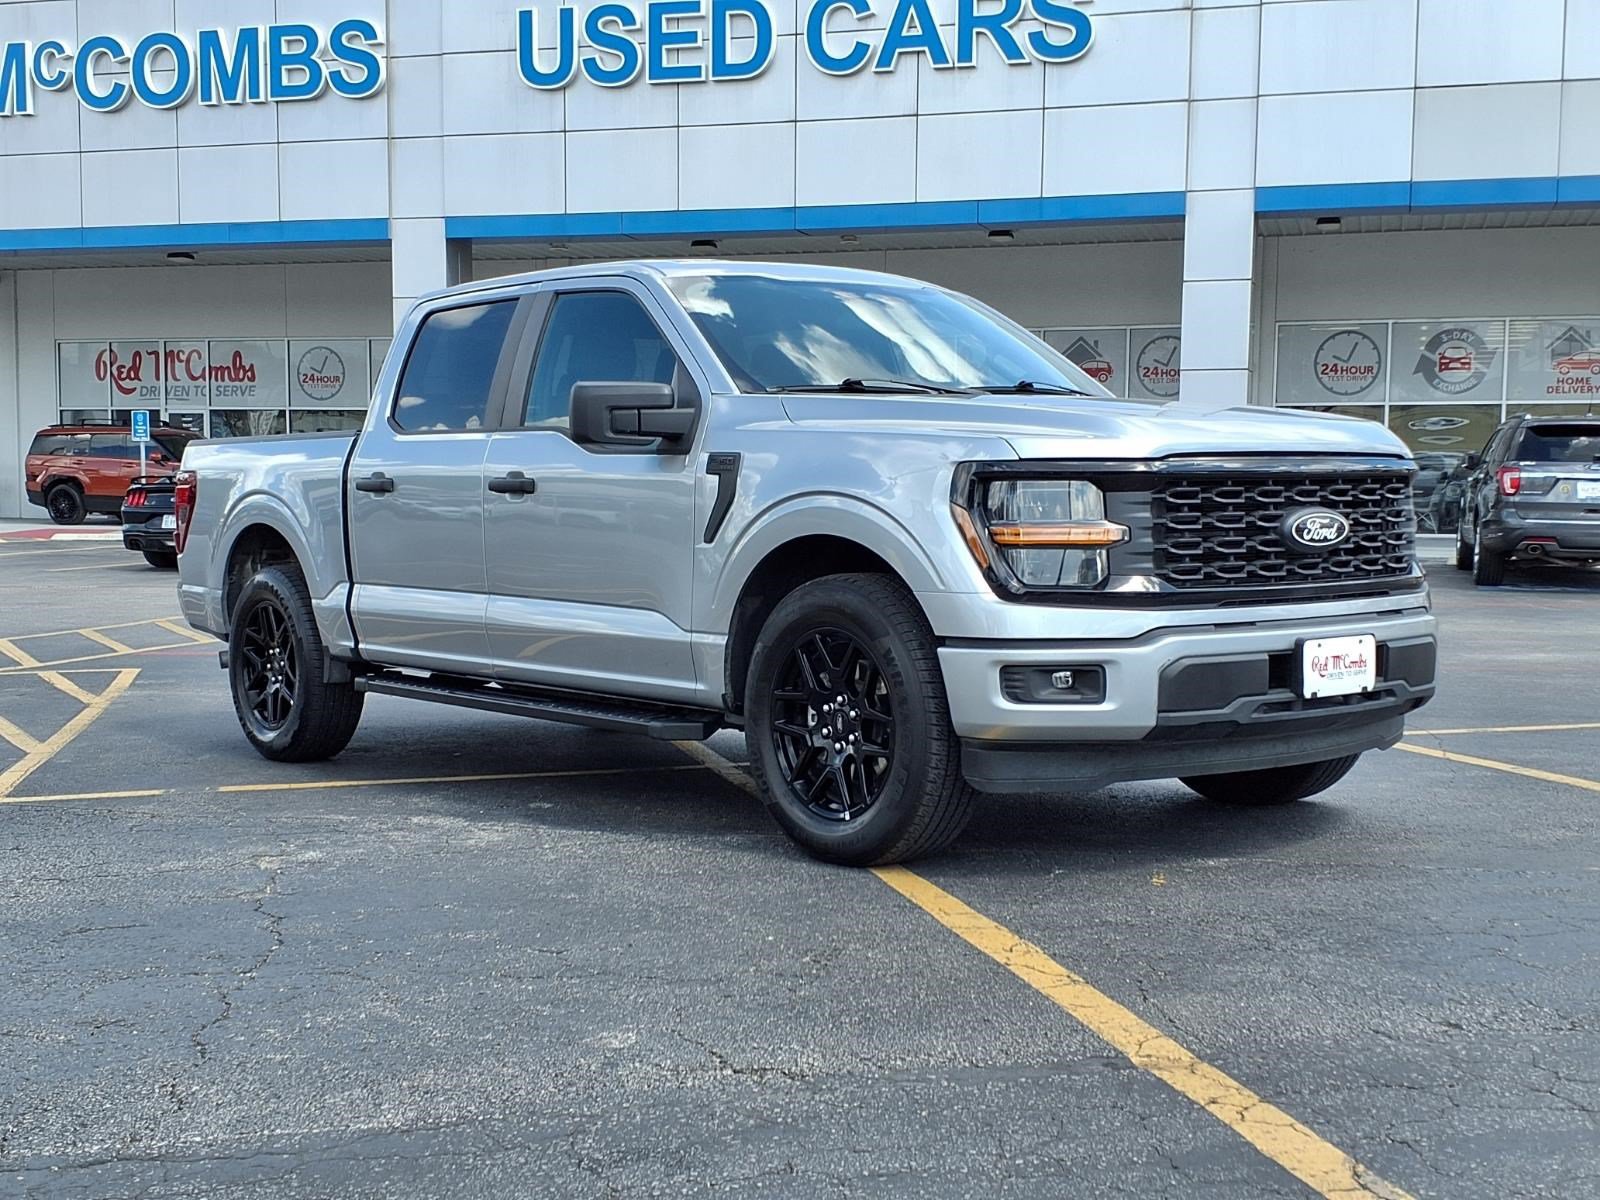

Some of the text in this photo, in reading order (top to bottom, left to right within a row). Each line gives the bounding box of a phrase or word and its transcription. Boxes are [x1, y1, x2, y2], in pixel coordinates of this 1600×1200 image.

[516, 0, 1095, 90] USED CARS
[95, 348, 257, 395] Red McCombs
[1556, 376, 1593, 386] HOME
[140, 385, 257, 397] DRIVEN TO SERVE
[1432, 377, 1478, 392] EXCHANGE
[1546, 385, 1600, 395] DELIVERY
[1303, 517, 1339, 540] Ford
[1311, 655, 1329, 678] Red
